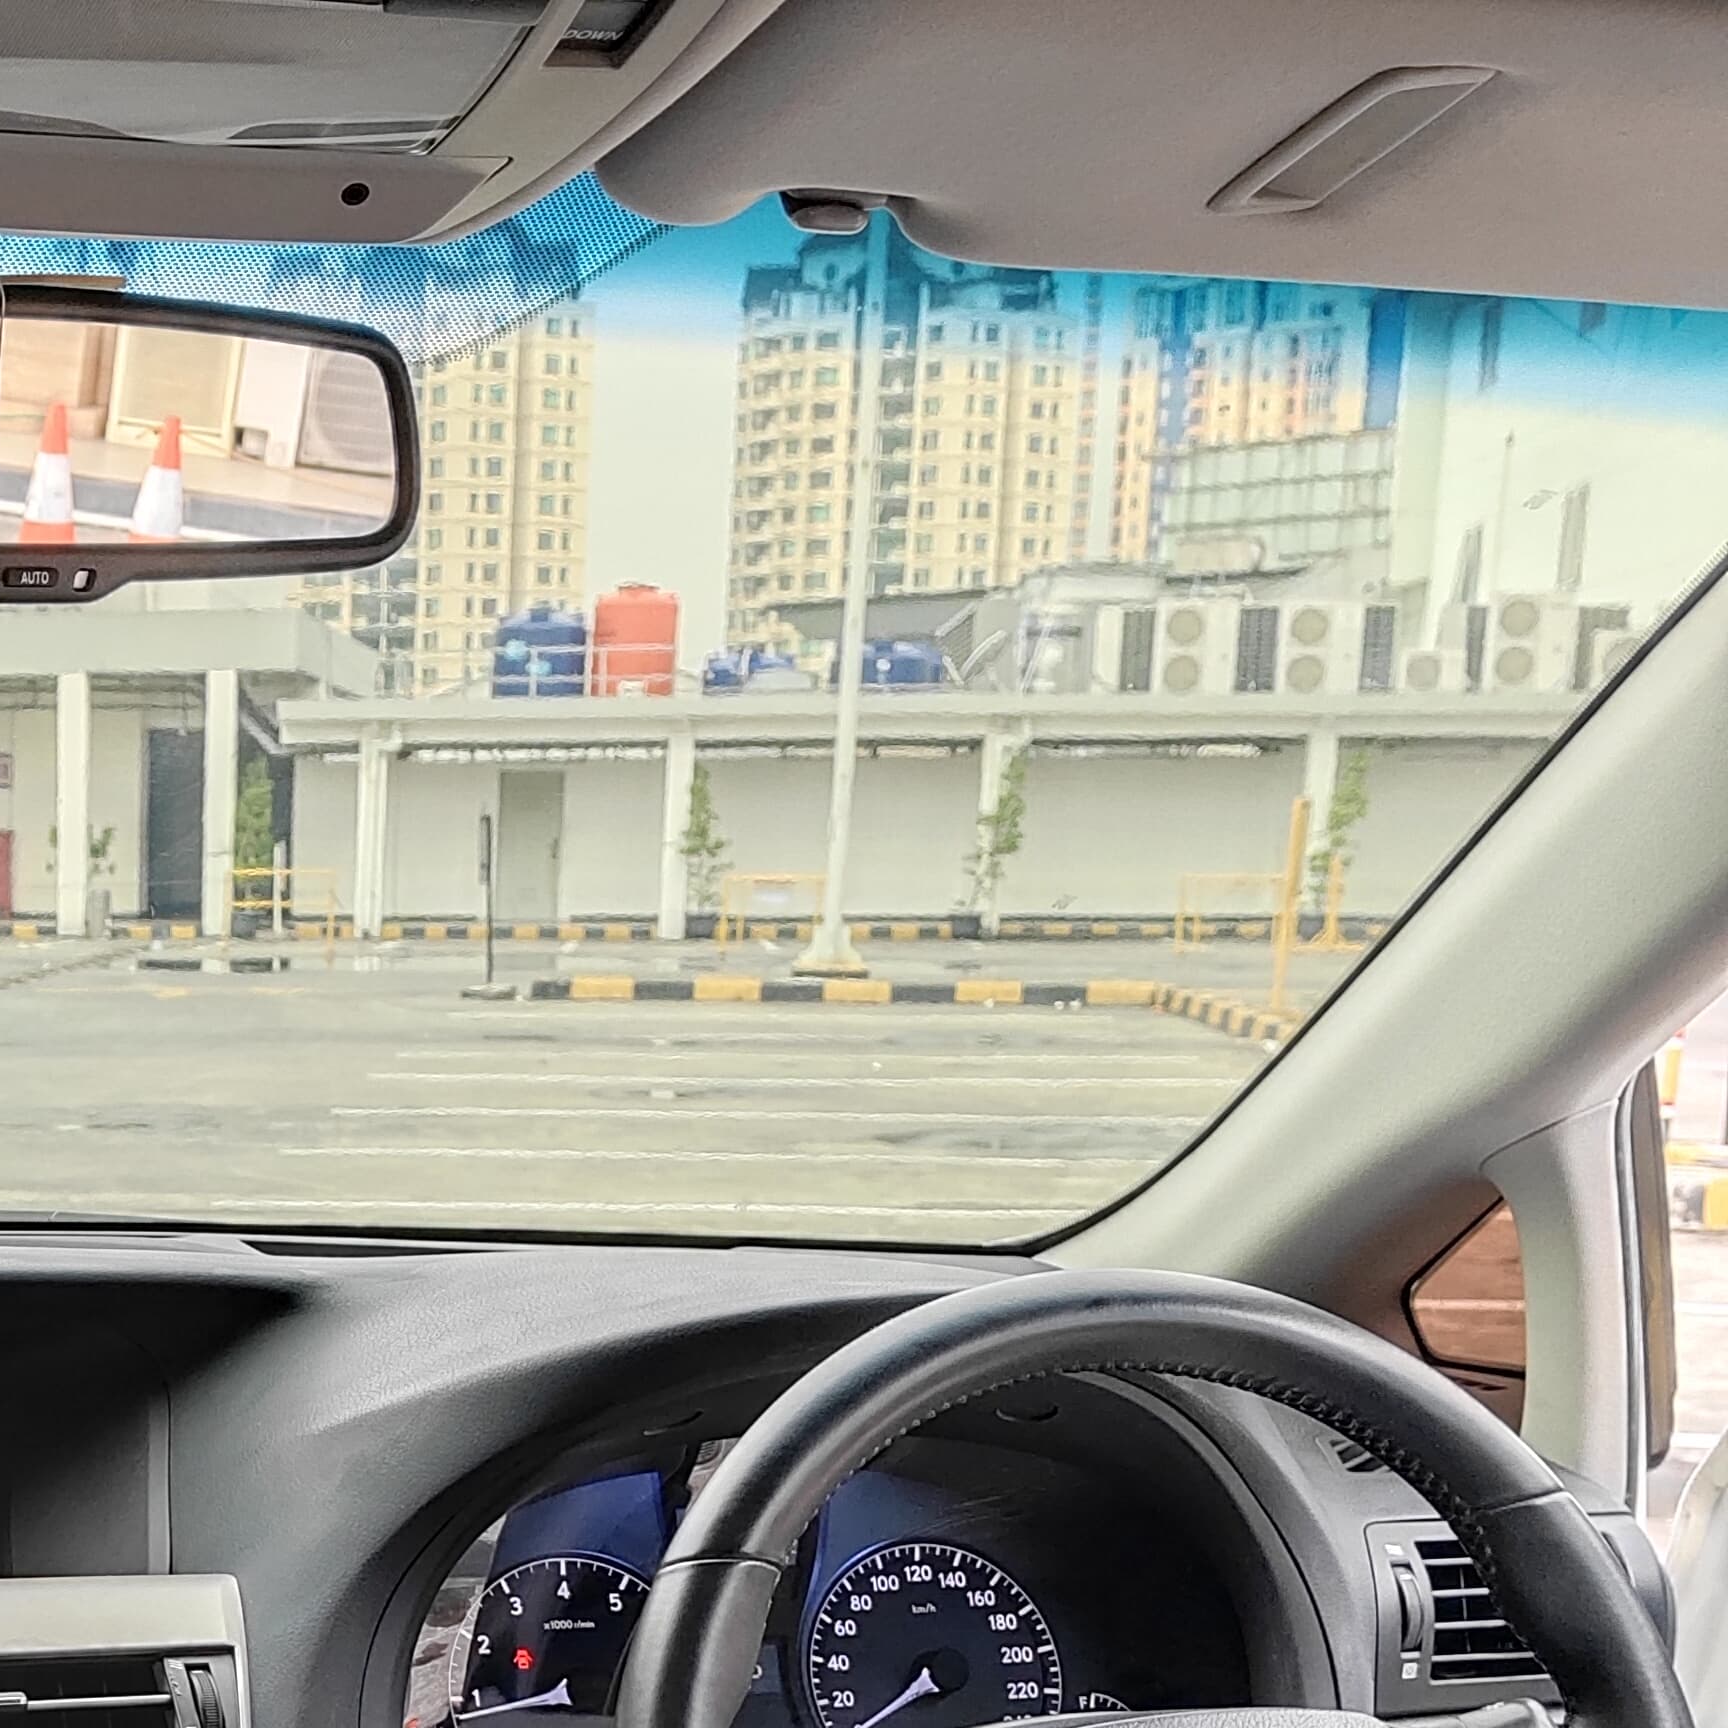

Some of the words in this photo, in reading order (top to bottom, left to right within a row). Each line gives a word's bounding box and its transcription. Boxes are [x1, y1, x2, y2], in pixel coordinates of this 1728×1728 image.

[20, 571, 49, 585] AUTO
[904, 1565, 932, 1582] 120
[938, 1571, 966, 1588] 140
[556, 1580, 571, 1599] 4
[870, 1575, 899, 1592] 100
[509, 1597, 523, 1615] 3
[608, 1593, 622, 1612] 5
[850, 1594, 872, 1611] 80
[966, 1590, 995, 1606] 160
[911, 1603, 937, 1614] km/h
[834, 1619, 856, 1637] 60
[988, 1613, 1017, 1631] 180
[477, 1635, 491, 1655] 2
[827, 1655, 849, 1671] 40
[1001, 1647, 1033, 1664] 200
[472, 1689, 480, 1707] 1
[832, 1691, 854, 1708] 20
[1007, 1682, 1038, 1700] 220
[1078, 1695, 1088, 1710] F
